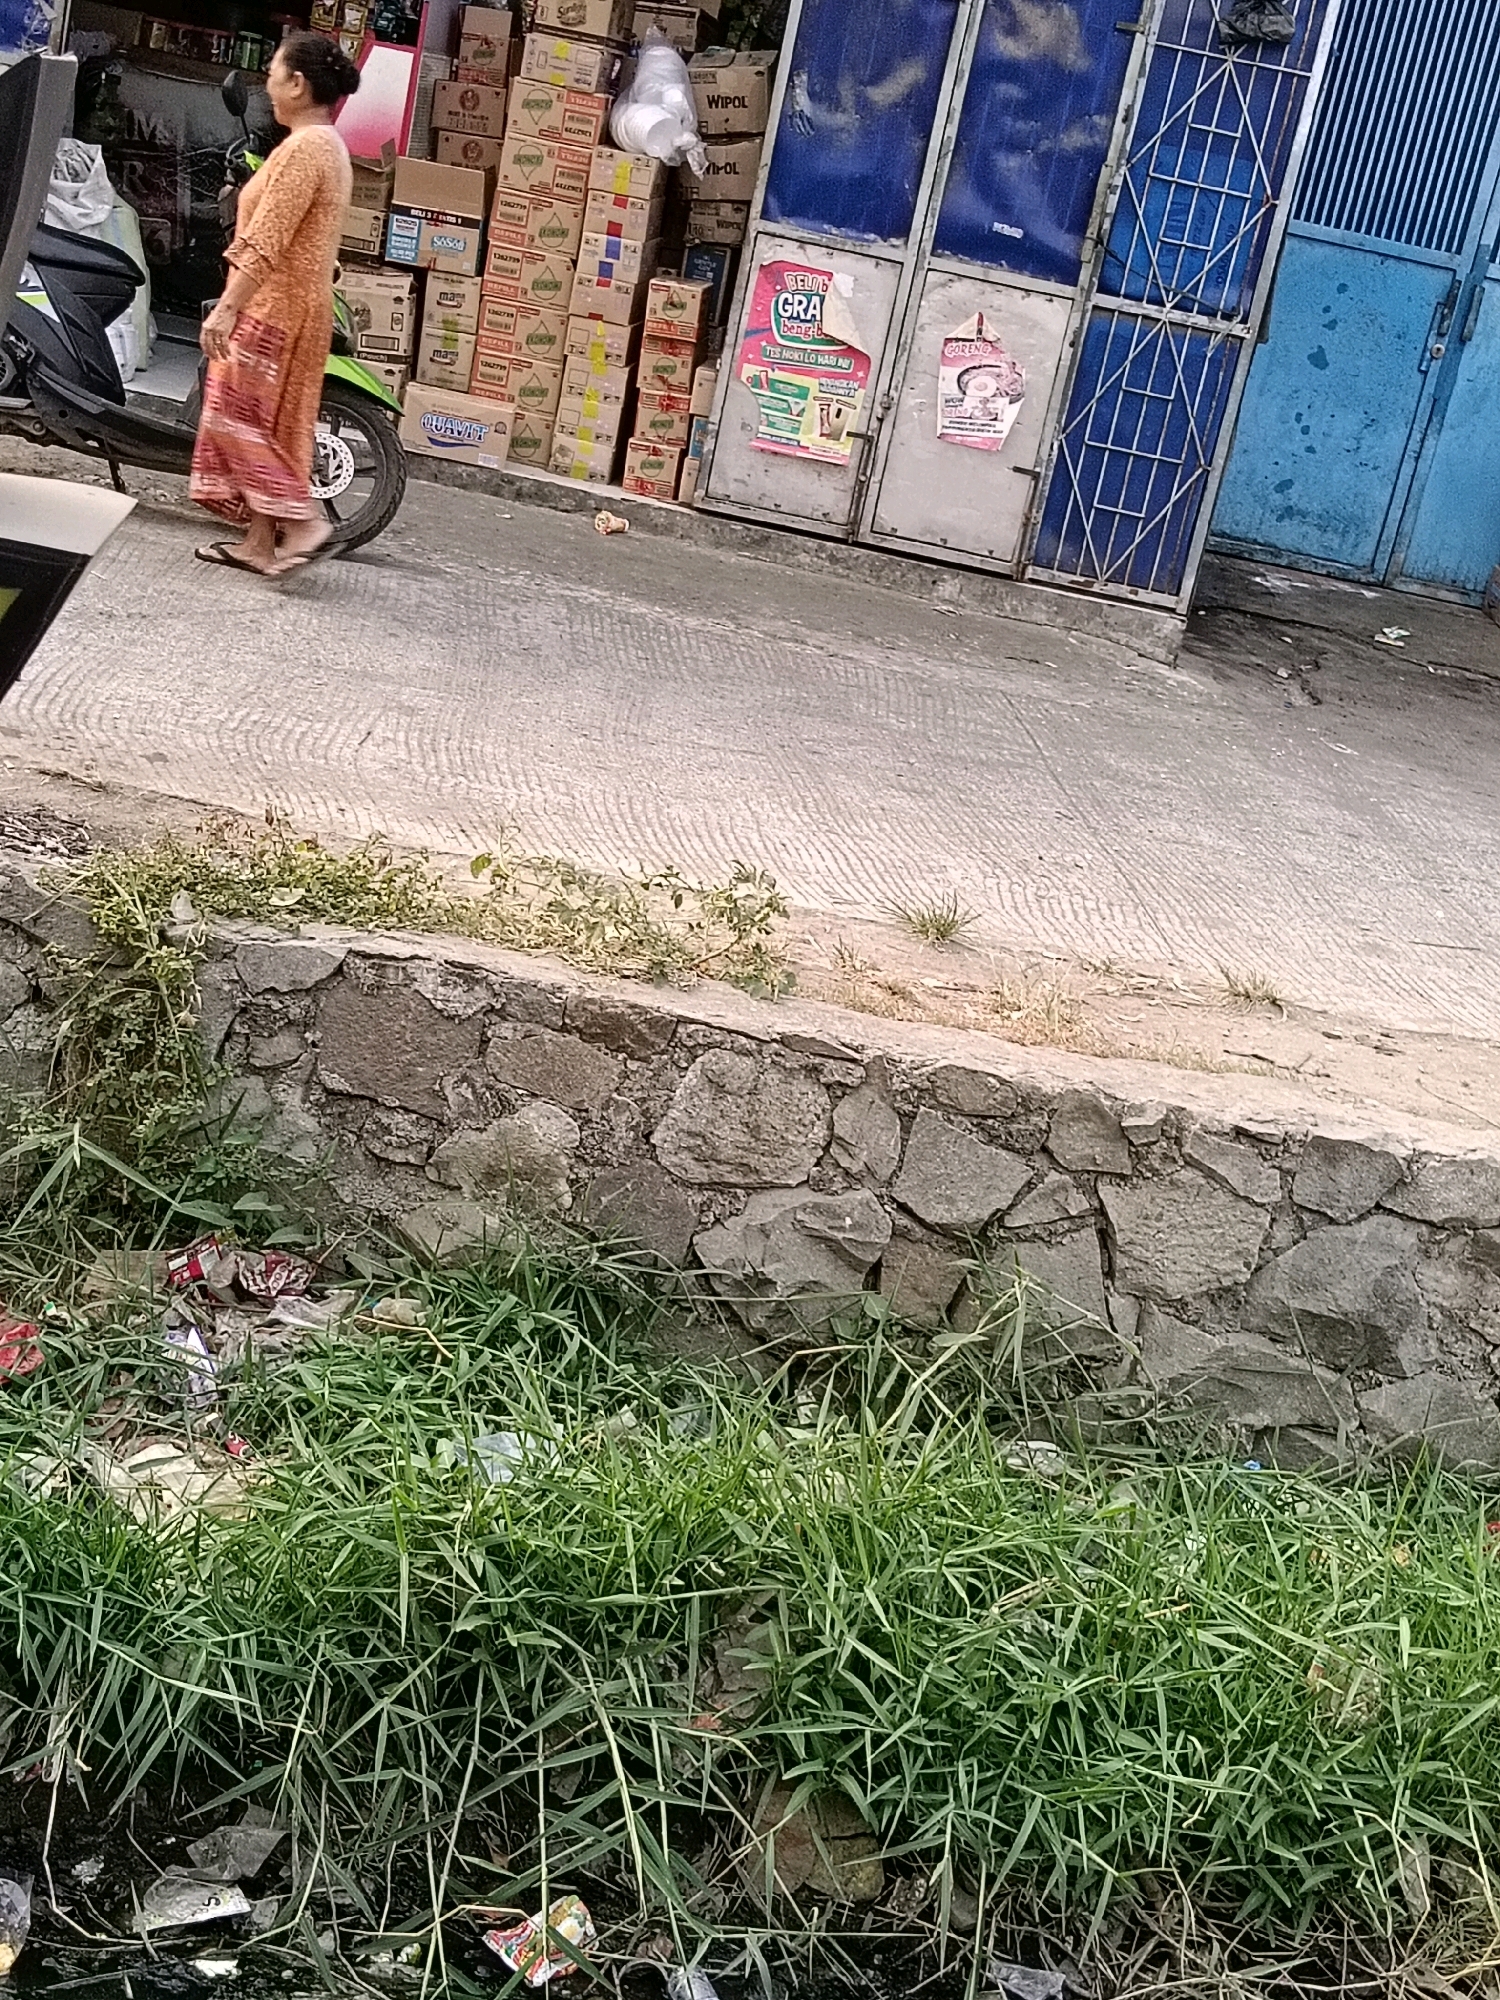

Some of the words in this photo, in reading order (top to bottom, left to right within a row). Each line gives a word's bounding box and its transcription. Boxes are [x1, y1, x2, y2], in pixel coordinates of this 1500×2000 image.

[706, 95, 748, 109] WIPOL
[785, 273, 819, 292] BELI
[778, 292, 822, 321] GRA
[766, 346, 781, 358] TES
[781, 349, 803, 361] HOKI
[805, 352, 815, 363] LO
[946, 343, 990, 356] GORENG
[421, 412, 489, 442] QUAVIT
